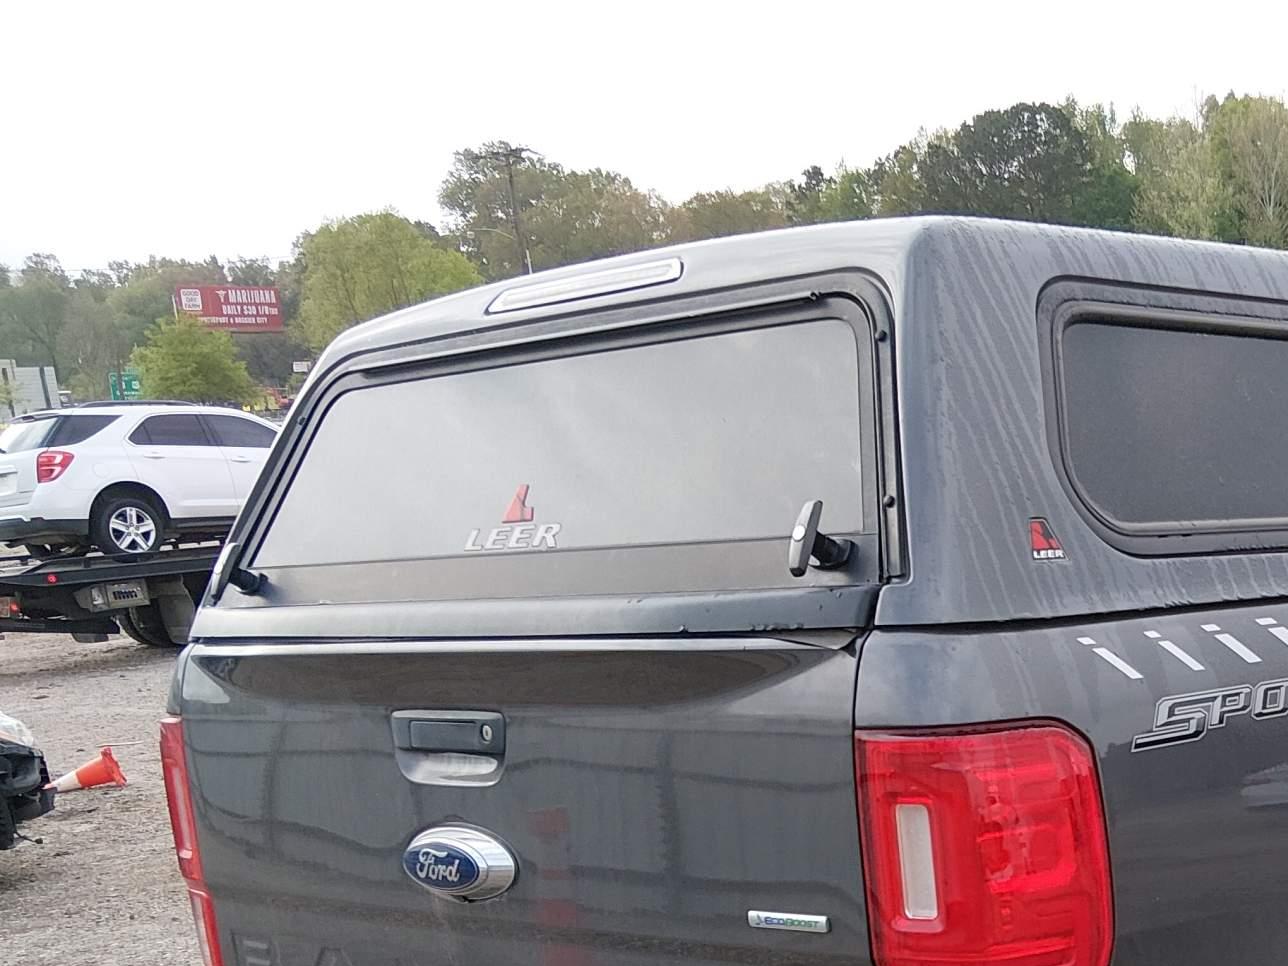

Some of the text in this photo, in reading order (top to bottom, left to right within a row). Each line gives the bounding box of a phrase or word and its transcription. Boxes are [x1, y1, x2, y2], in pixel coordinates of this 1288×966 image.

[228, 289, 276, 303] MARIJUANA
[222, 305, 241, 315] DAILY
[243, 305, 257, 315] $30
[463, 523, 561, 552] LEER
[1033, 549, 1065, 559] LEER
[416, 847, 461, 883] Ford
